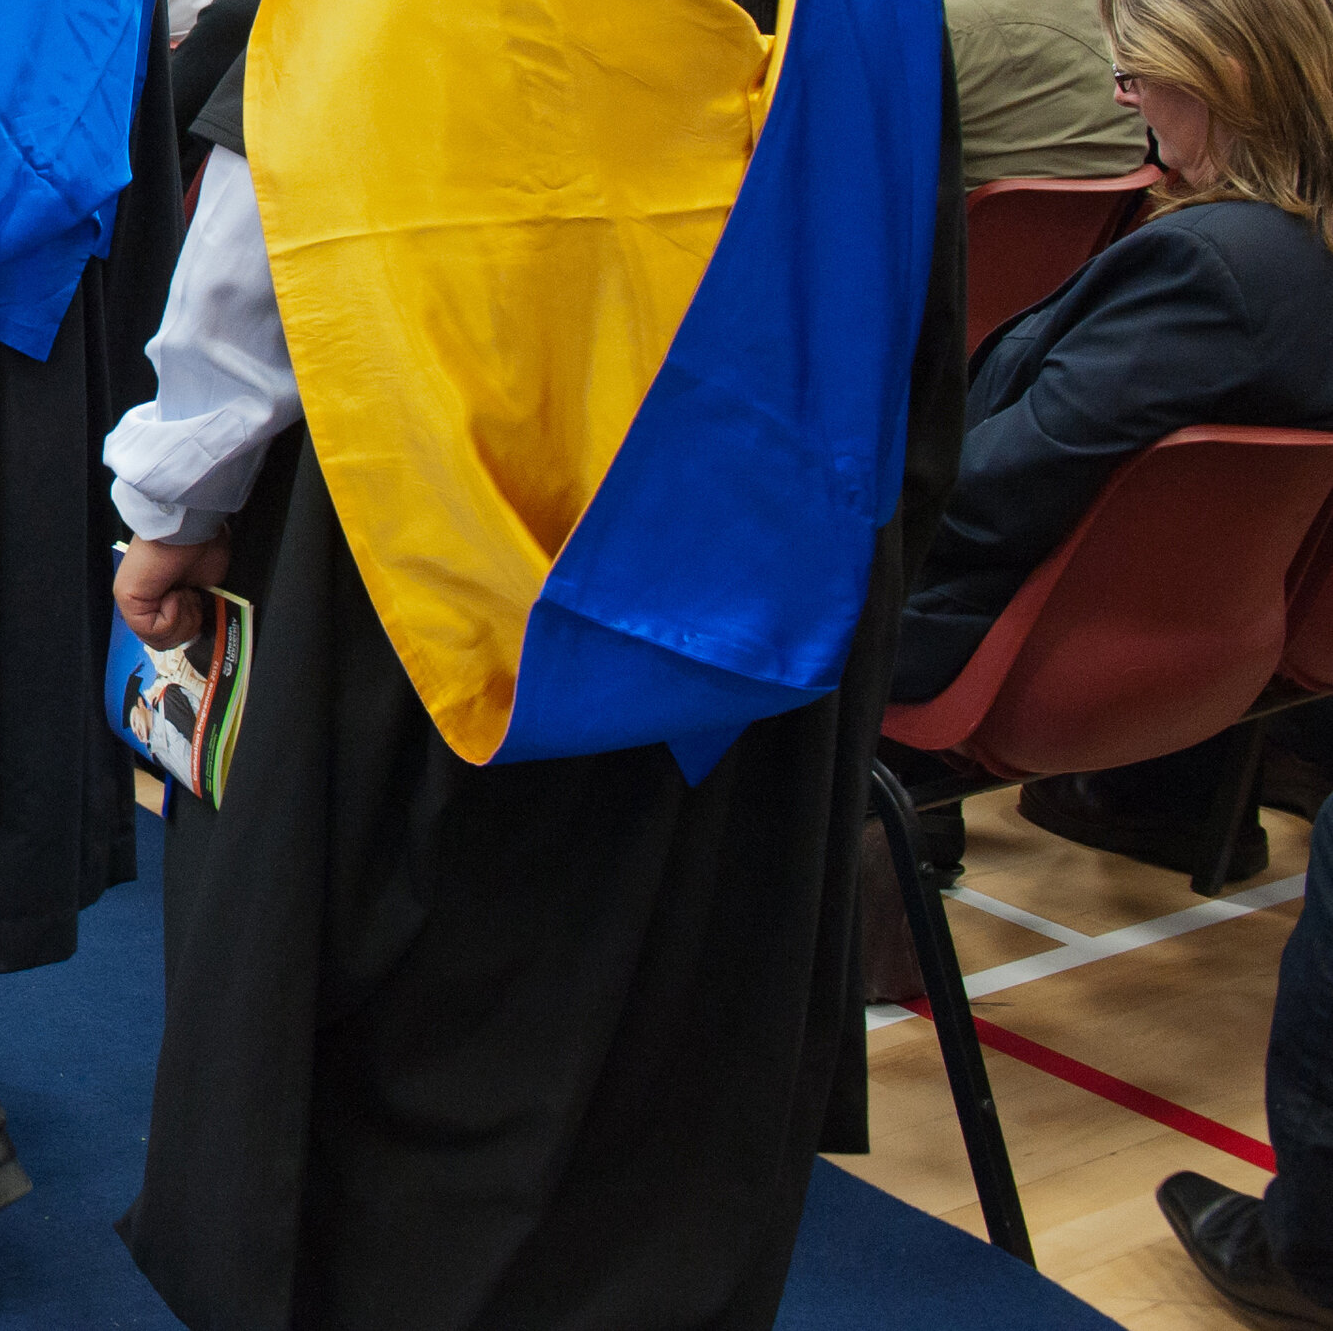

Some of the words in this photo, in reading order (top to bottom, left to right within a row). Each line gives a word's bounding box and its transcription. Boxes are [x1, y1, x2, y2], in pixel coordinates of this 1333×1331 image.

[192, 733, 201, 781] Graduation
[197, 682, 214, 731] Programme
[210, 660, 220, 681] 2012
